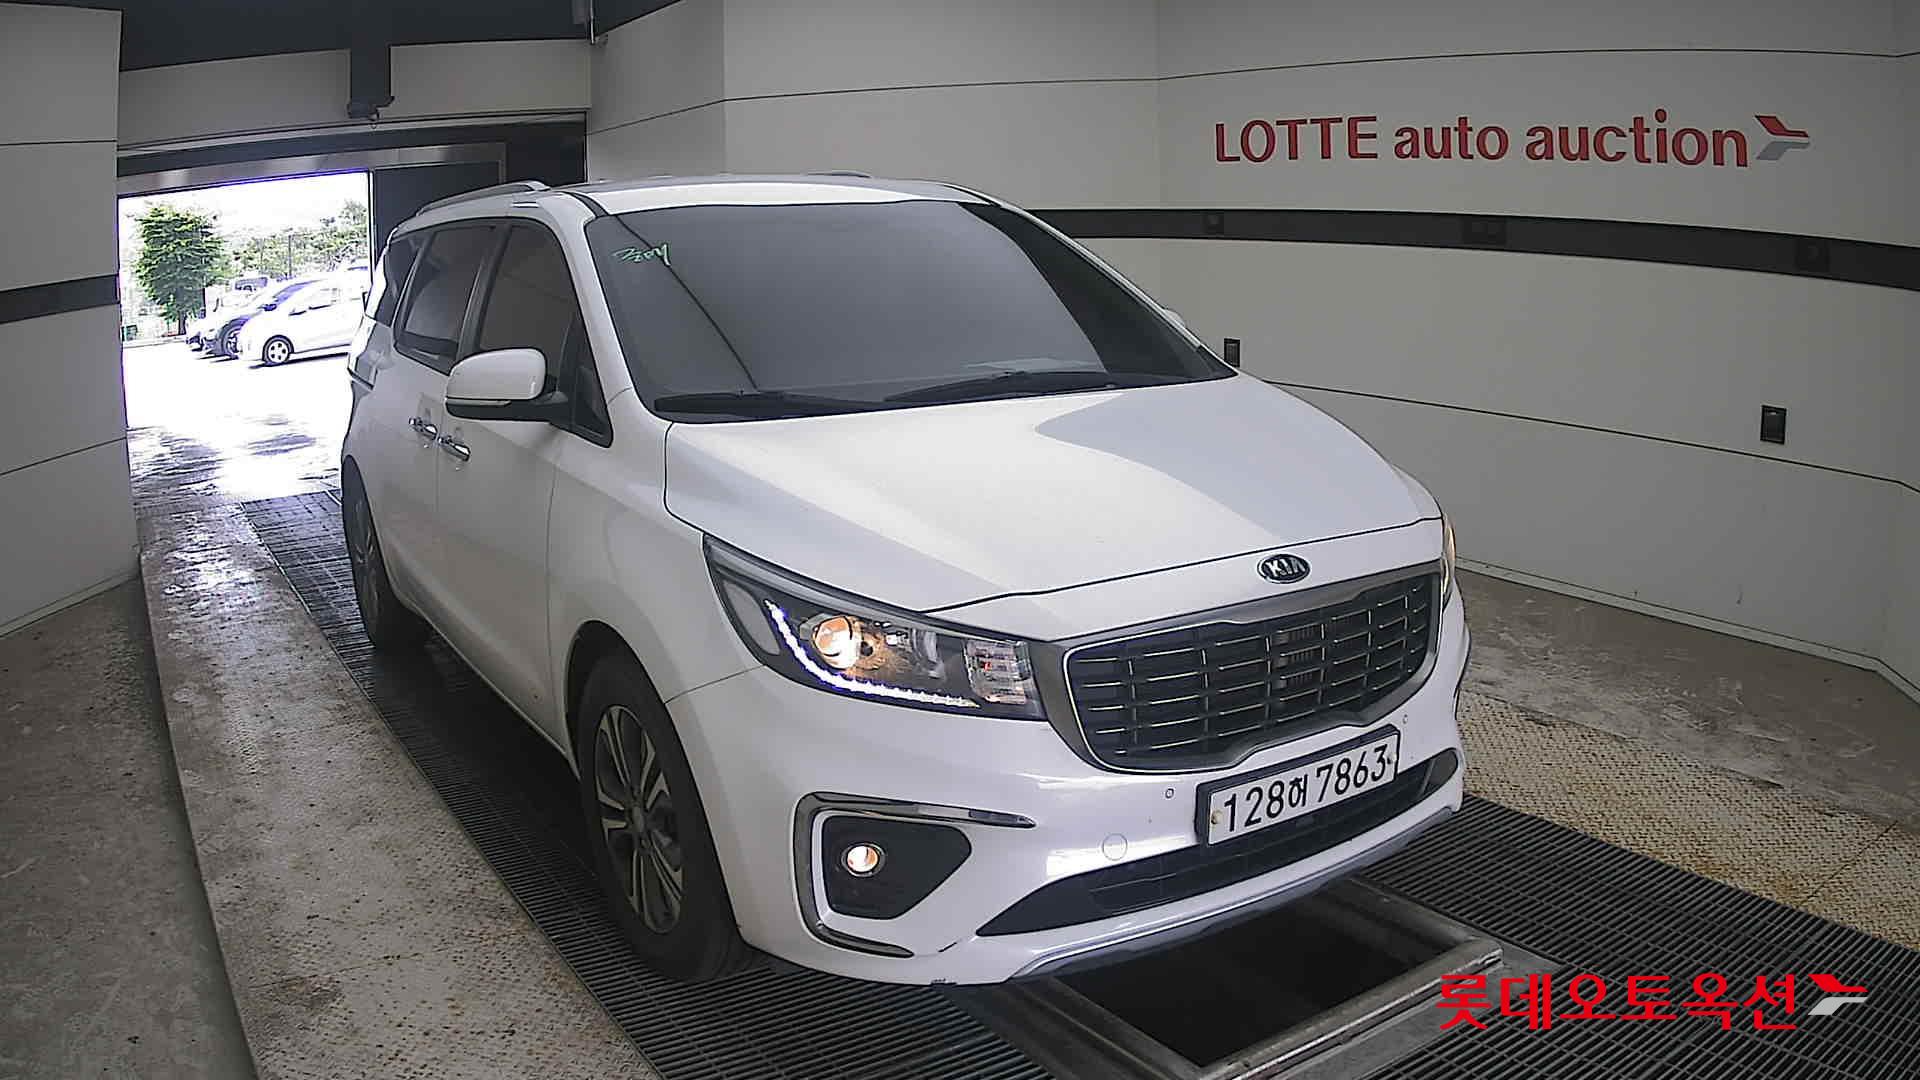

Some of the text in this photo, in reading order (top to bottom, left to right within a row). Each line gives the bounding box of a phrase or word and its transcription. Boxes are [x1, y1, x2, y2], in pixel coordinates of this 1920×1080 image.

[1214, 109, 1748, 168] LOTTE auto auction
[1264, 556, 1306, 578] KIA
[1315, 743, 1389, 803] 7863
